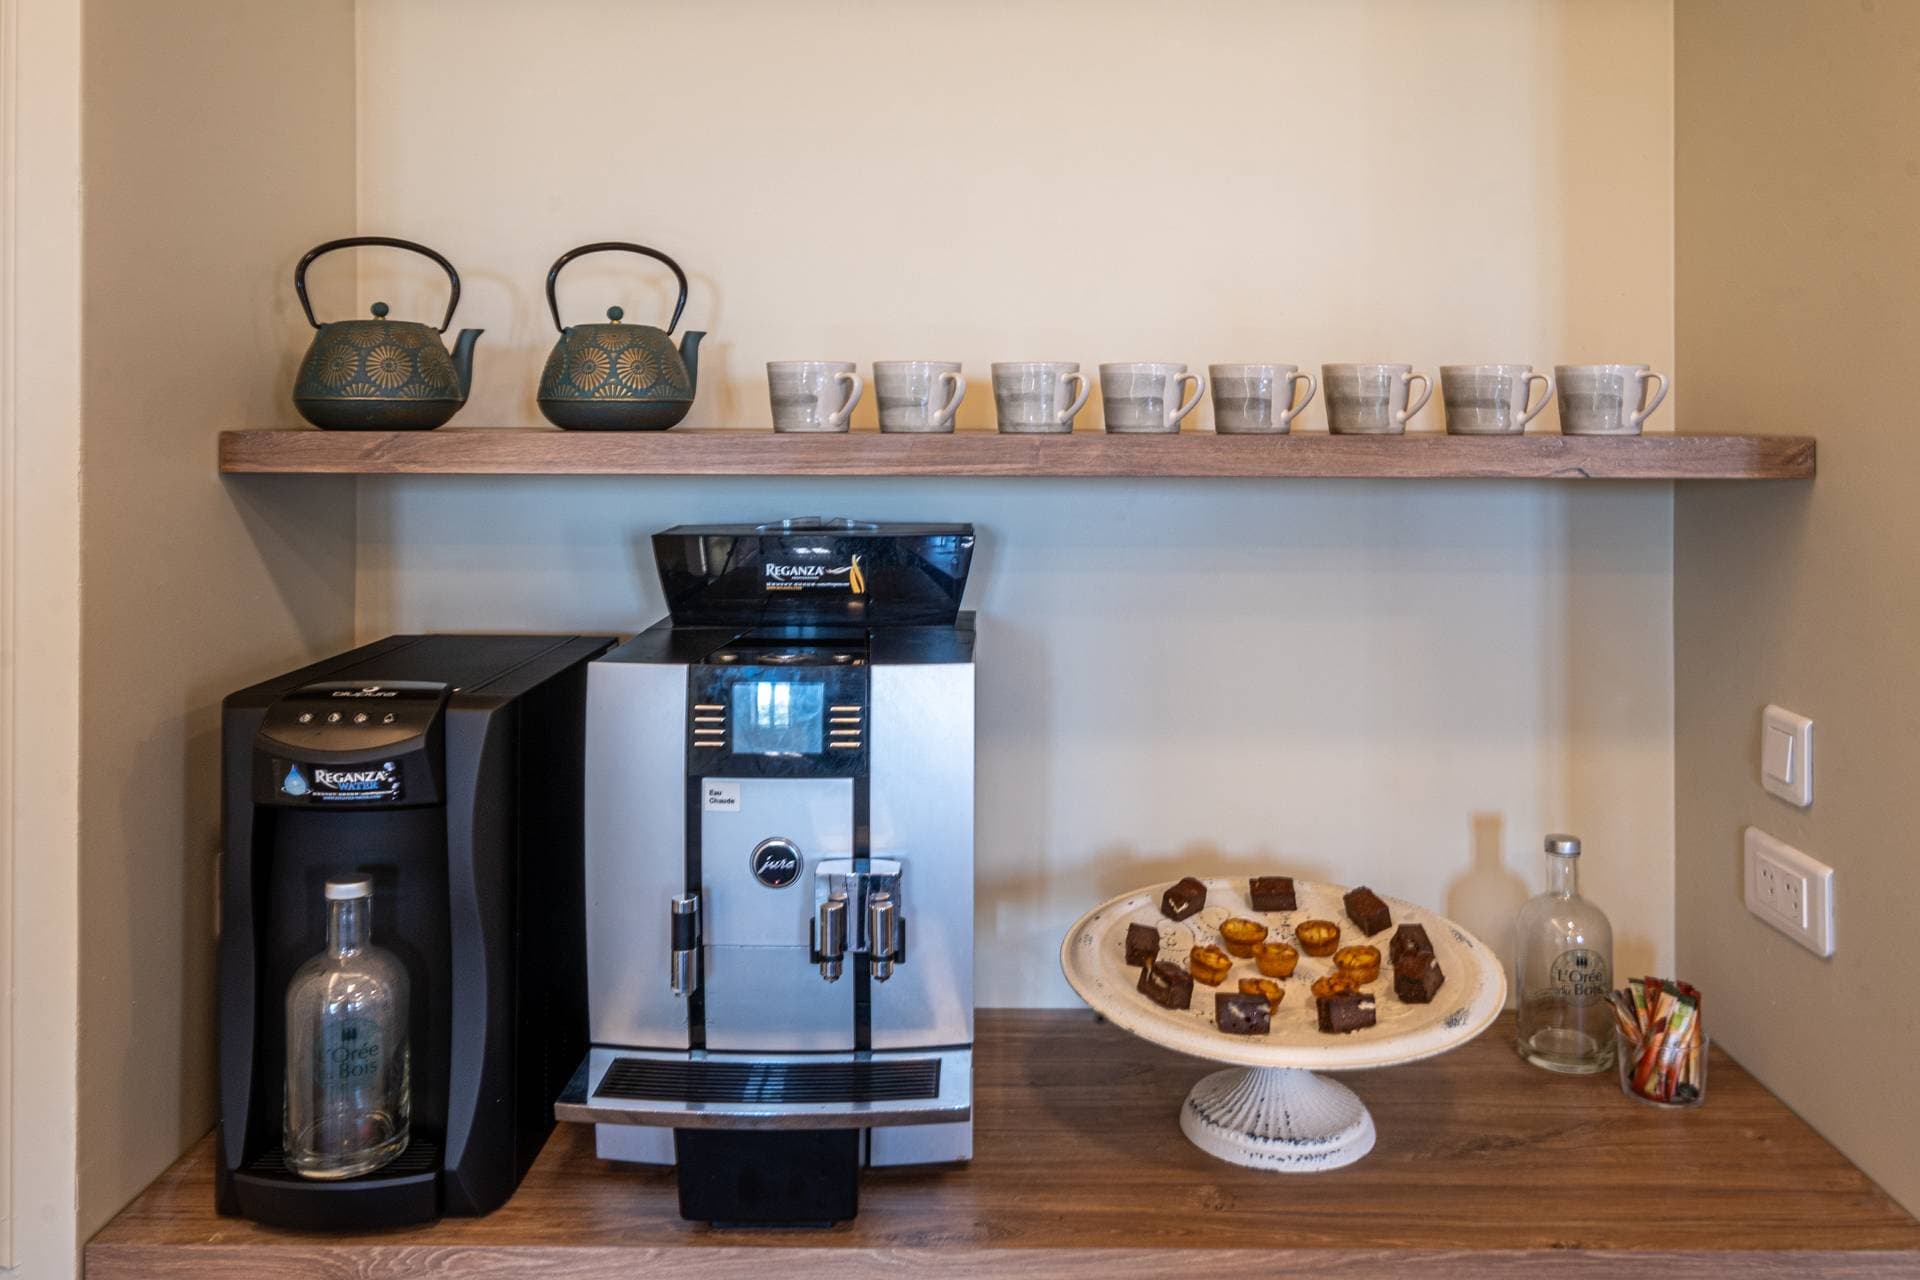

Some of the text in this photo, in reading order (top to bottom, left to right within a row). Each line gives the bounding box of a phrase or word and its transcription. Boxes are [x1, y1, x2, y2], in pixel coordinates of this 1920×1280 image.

[765, 563, 824, 581] REGANZA
[314, 769, 386, 789] REGANZA
[337, 780, 380, 791] WATER
[757, 854, 796, 875] jura
